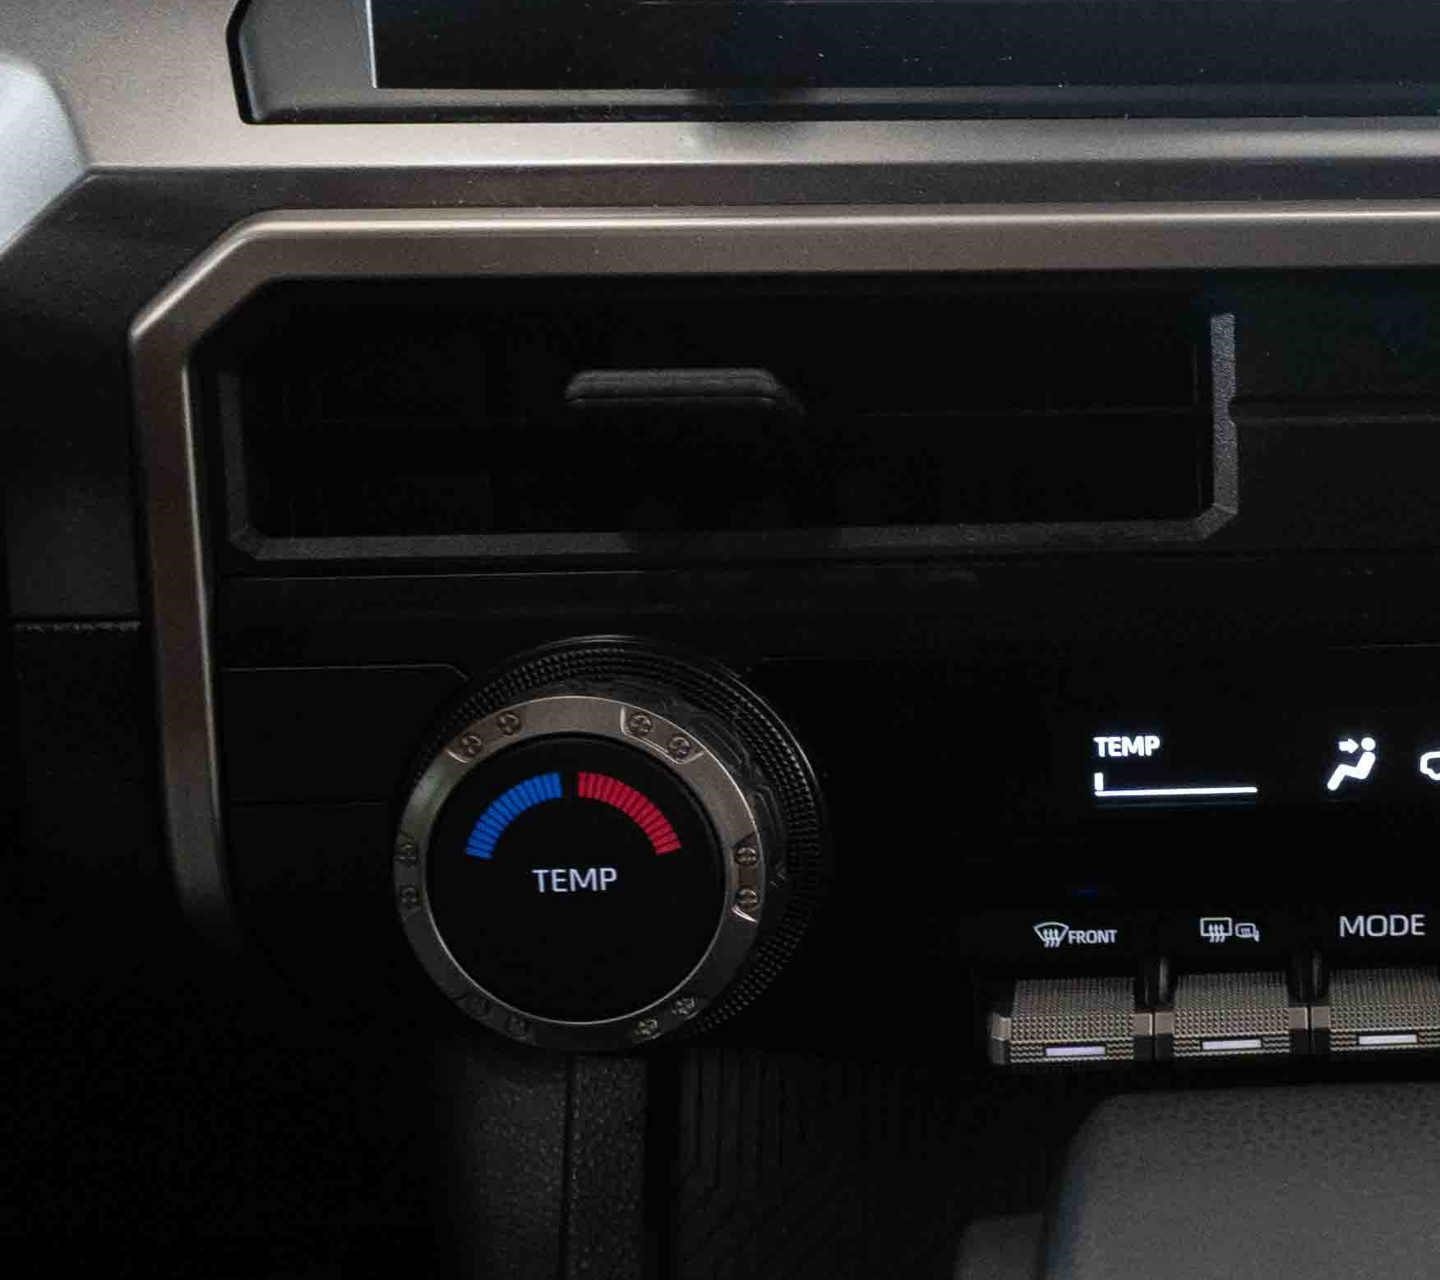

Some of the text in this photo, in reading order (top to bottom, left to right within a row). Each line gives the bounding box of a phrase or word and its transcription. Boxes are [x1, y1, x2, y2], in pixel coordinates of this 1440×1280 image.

[1092, 733, 1162, 759] TEMP
[530, 866, 618, 894] TEMP
[1066, 928, 1119, 946] FRONT
[1338, 913, 1426, 939] MODE
